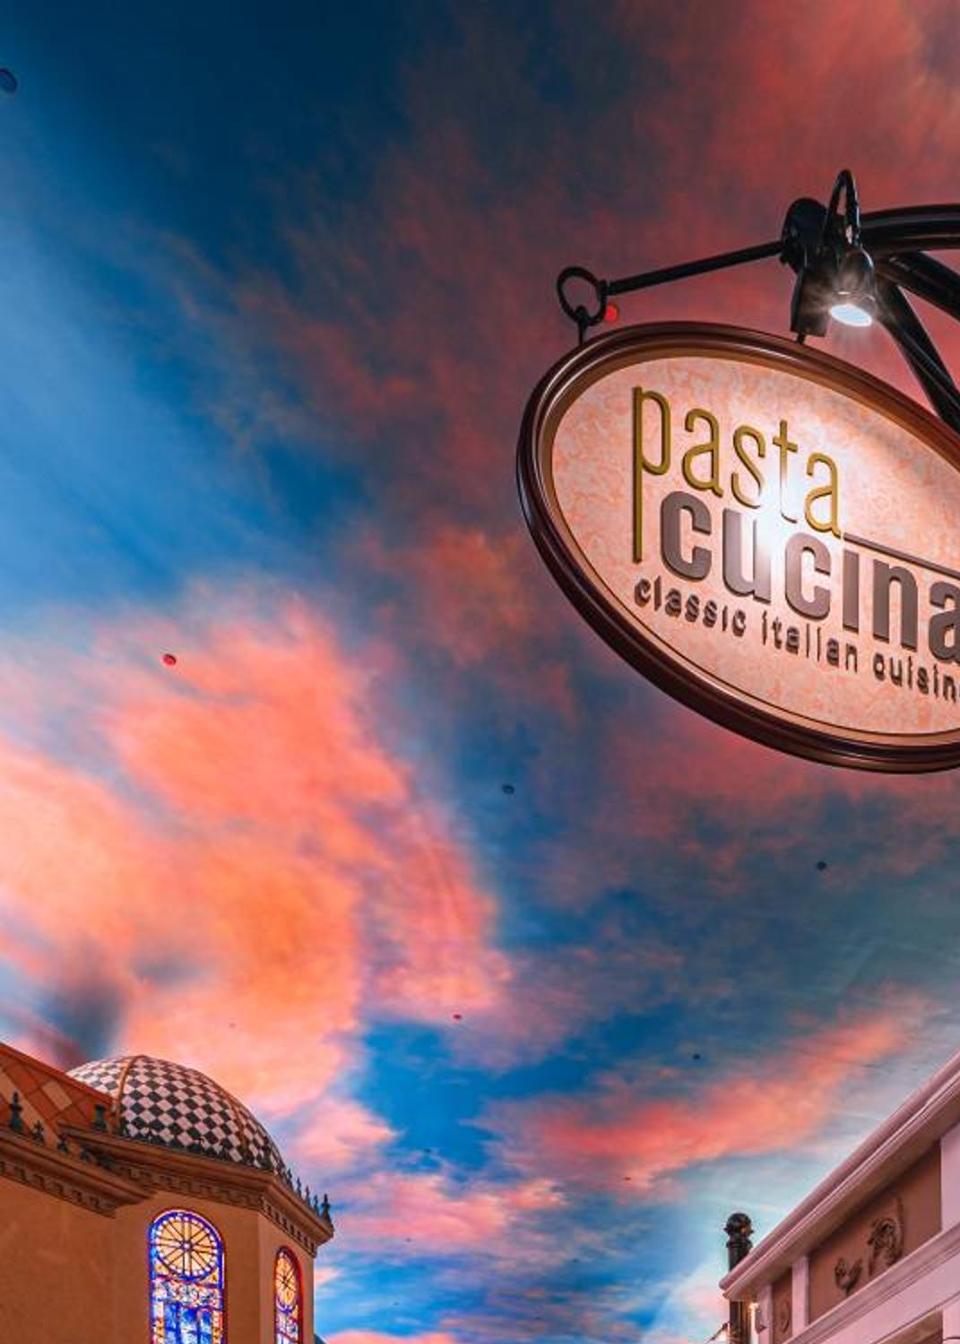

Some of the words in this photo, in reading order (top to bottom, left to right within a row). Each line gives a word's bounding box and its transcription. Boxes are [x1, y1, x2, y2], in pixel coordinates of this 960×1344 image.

[632, 386, 841, 564] pasta
[634, 576, 747, 637] classic
[761, 610, 858, 672] italian
